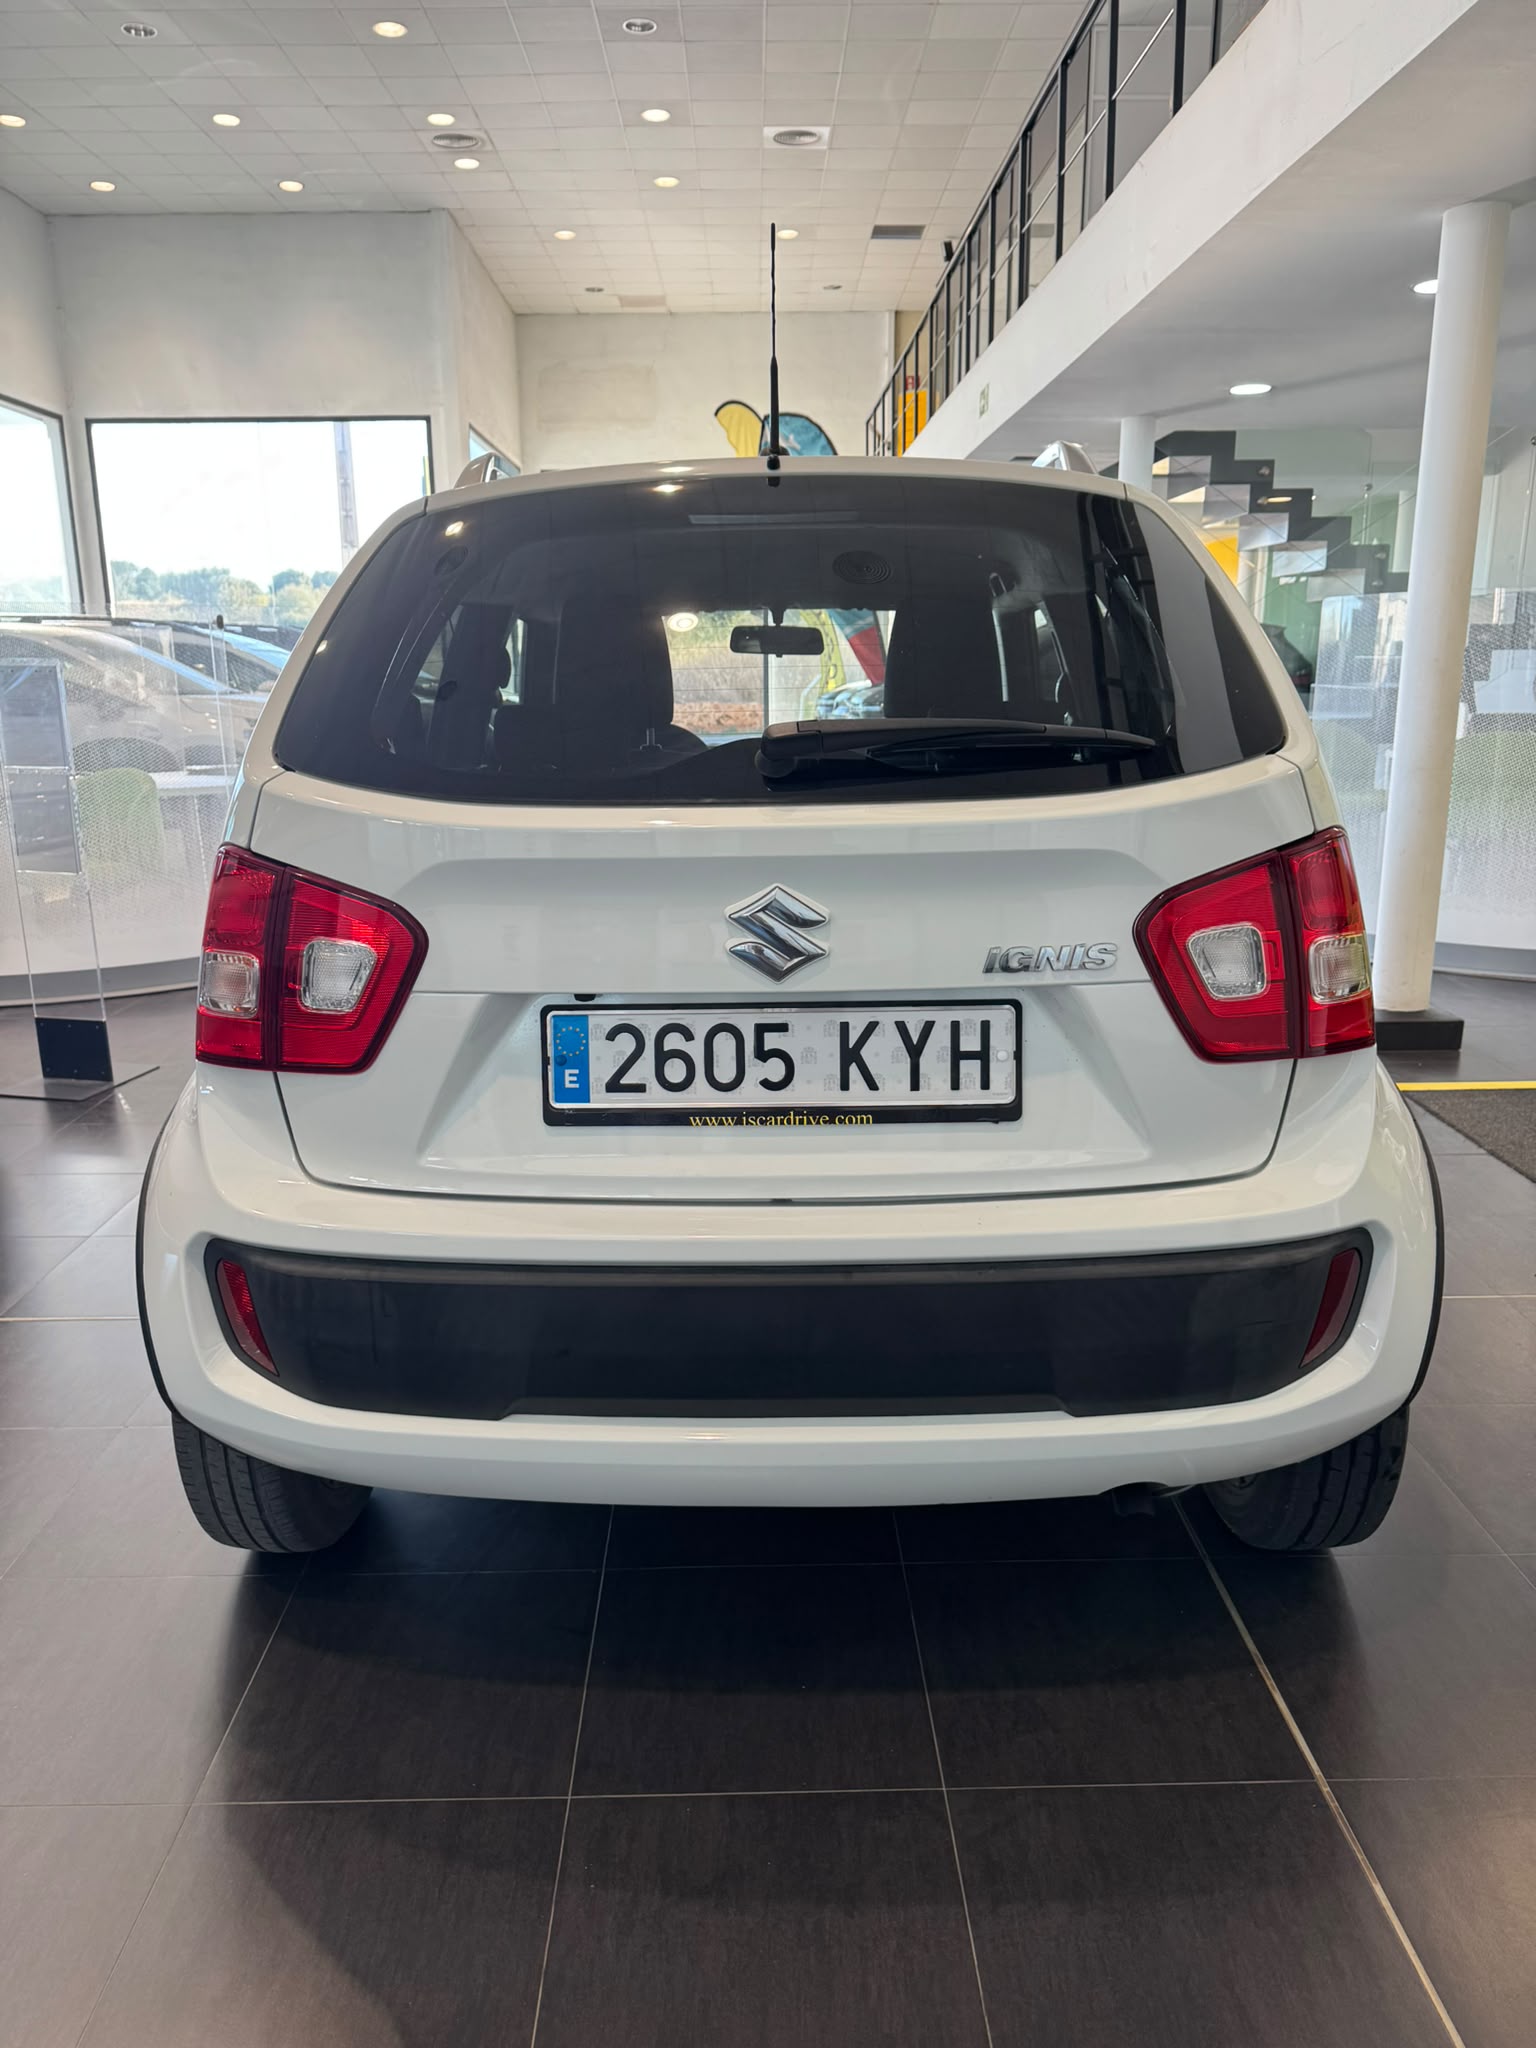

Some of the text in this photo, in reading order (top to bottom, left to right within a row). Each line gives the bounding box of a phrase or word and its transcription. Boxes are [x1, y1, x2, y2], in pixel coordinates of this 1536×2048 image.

[983, 943, 1118, 974] IGNIS
[605, 1020, 991, 1093] 2605 KYH
[564, 1069, 580, 1089] E
[688, 1110, 874, 1127] www.iscardrive.com
